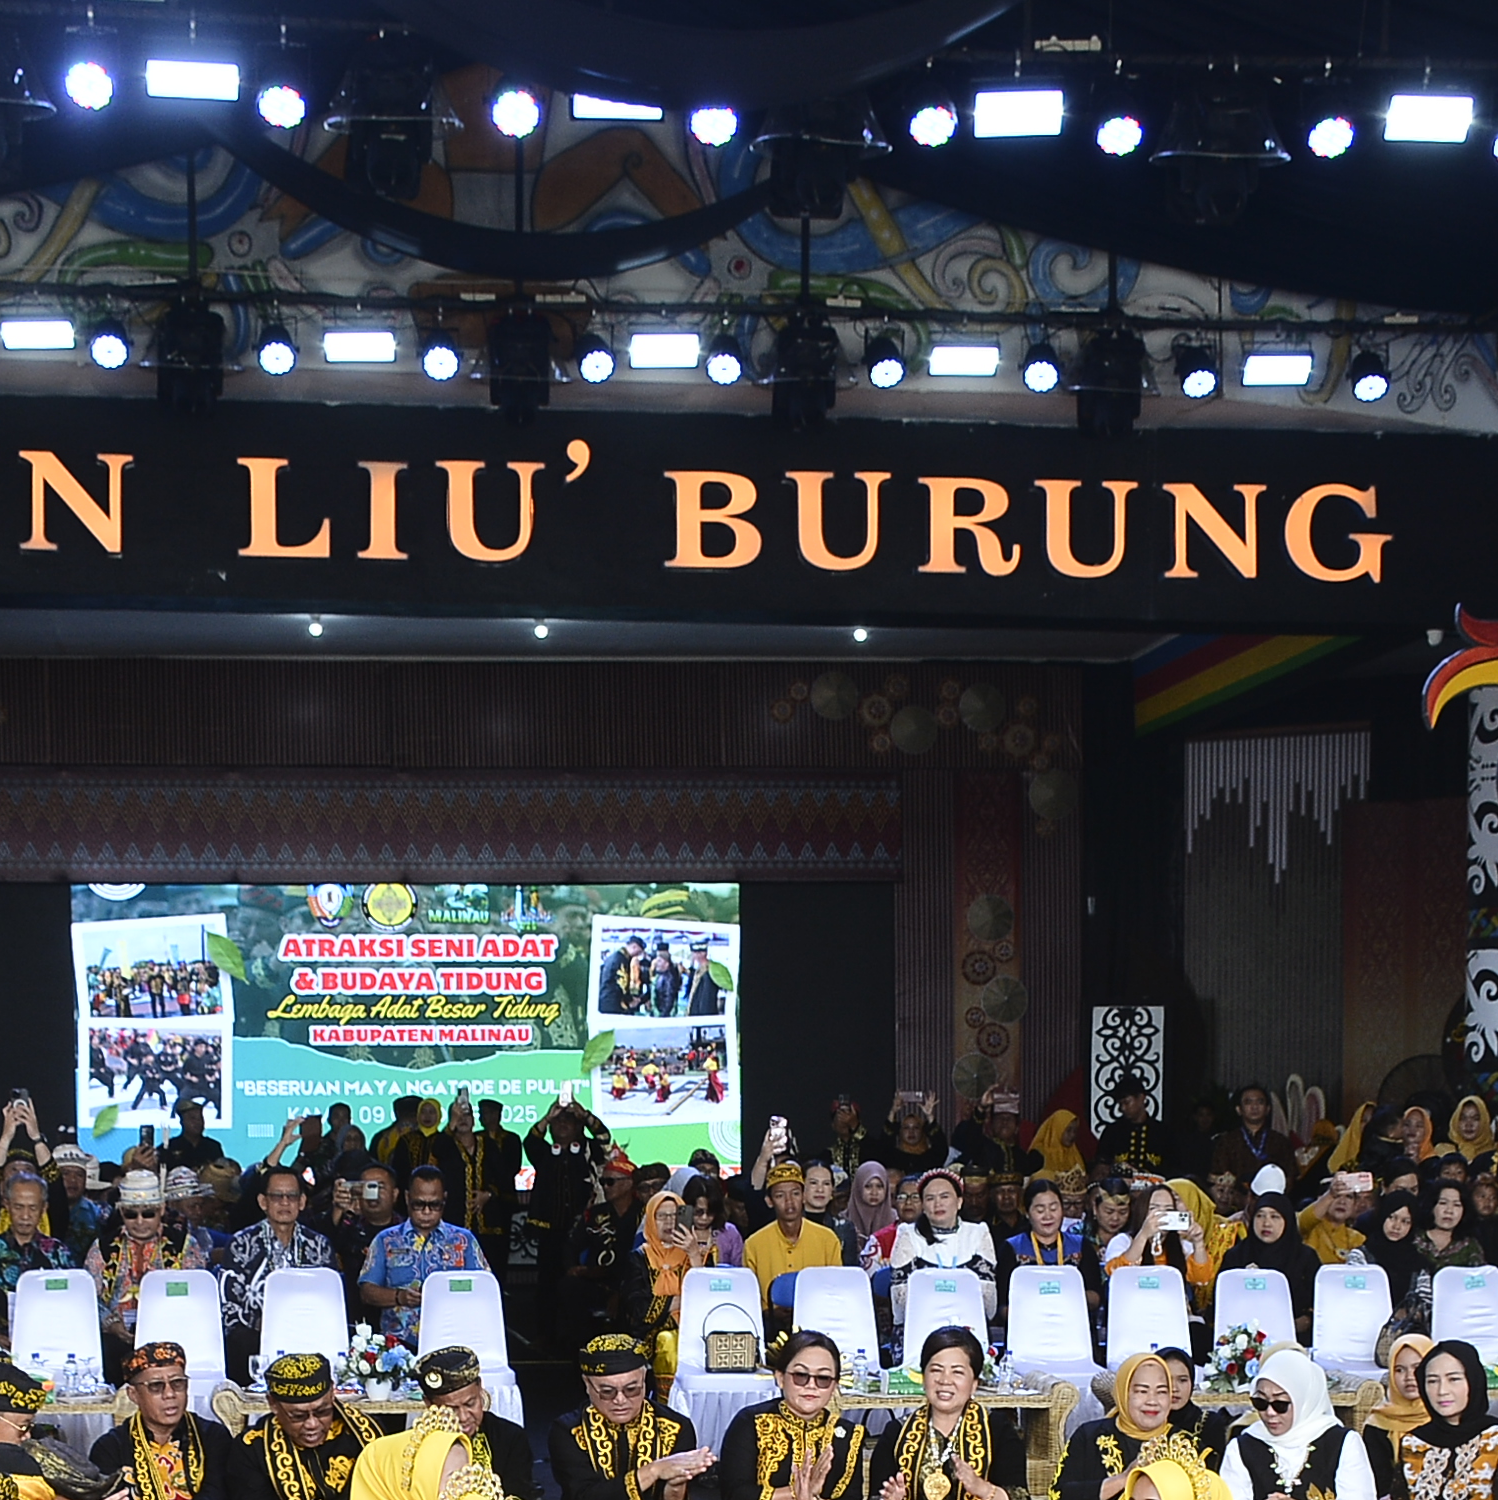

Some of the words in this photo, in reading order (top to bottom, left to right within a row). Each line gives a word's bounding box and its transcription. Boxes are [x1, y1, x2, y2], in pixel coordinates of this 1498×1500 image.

[663, 469, 1394, 584] BURUNG
[428, 909, 490, 924] MALINAU
[282, 938, 405, 958] ATRAKSI
[410, 938, 475, 958] SENI
[481, 938, 556, 958] ADAT
[294, 971, 315, 991] &
[320, 971, 435, 991] BUDAYA
[440, 971, 544, 991] TIDUNG
[267, 994, 368, 1026] Lembaga
[369, 995, 424, 1019] Adat
[425, 995, 487, 1019] Besar
[492, 994, 560, 1026] Tidung
[312, 1028, 434, 1043] KABUPATEN
[439, 1028, 531, 1043] MALINAU
[344, 1080, 402, 1096] MAYA
[499, 1079, 522, 1095] DE
[526, 1079, 591, 1095] PULT"
[359, 1105, 386, 1124] 09
[501, 1104, 538, 1123] 025
